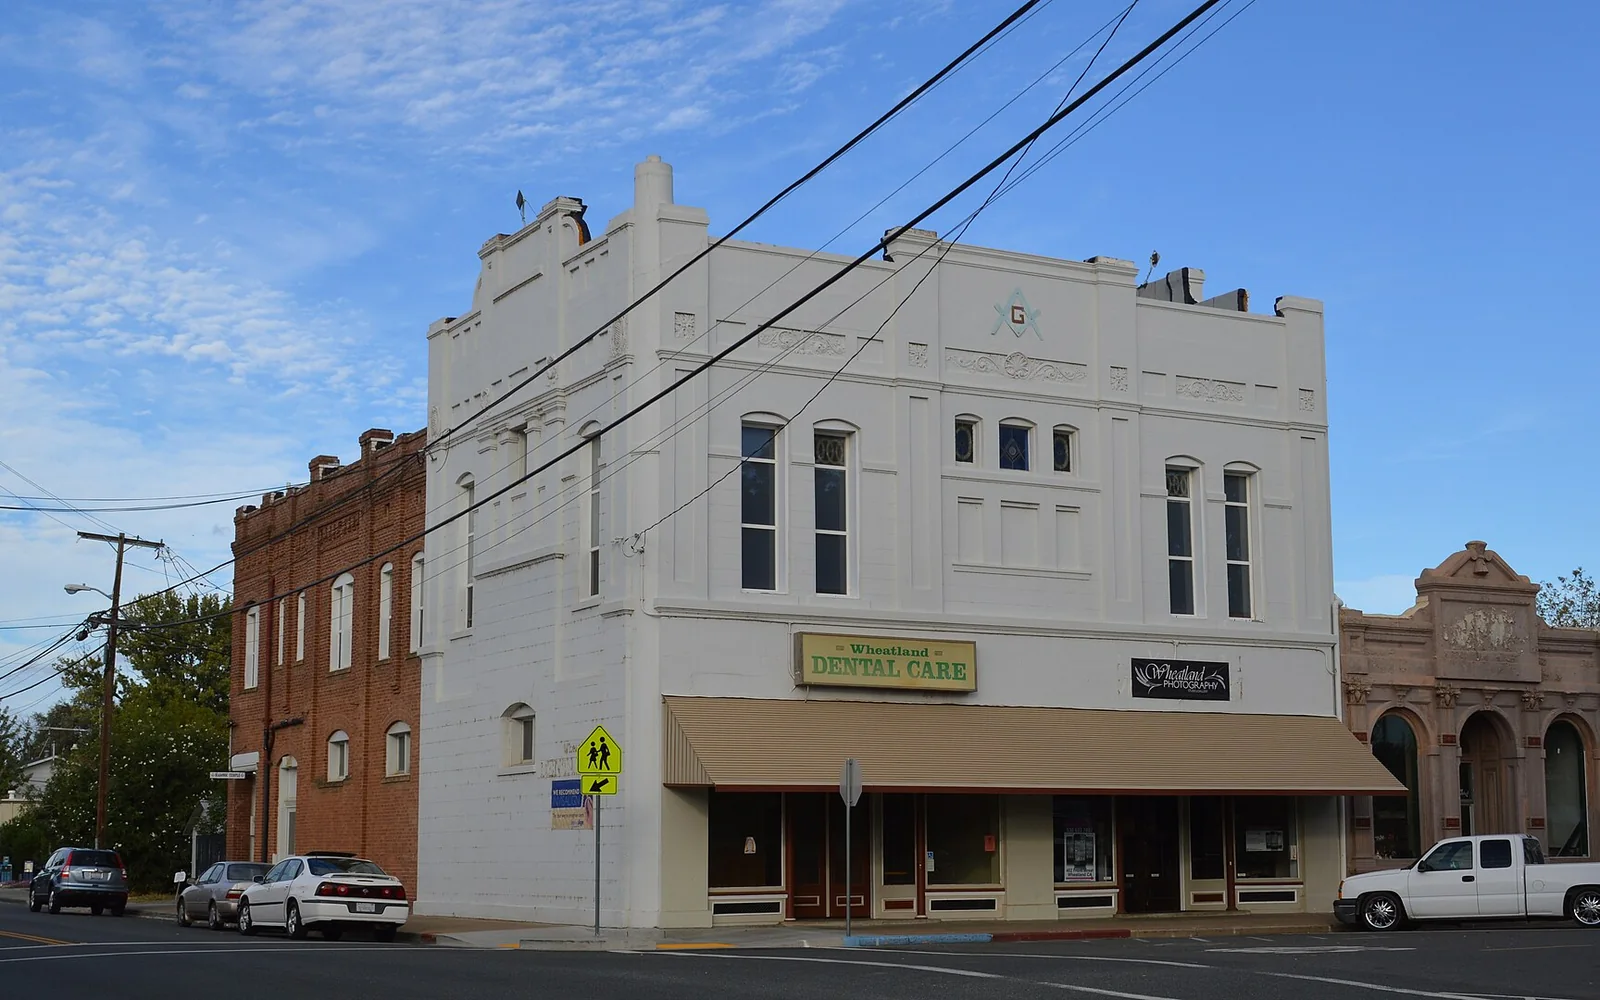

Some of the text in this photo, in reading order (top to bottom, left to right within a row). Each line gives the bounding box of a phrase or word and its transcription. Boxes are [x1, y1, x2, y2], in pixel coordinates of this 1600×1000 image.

[1011, 305, 1025, 324] G
[850, 643, 929, 658] Wheatland
[811, 655, 967, 681] DENTAL CARE
[1145, 662, 1206, 682] Wheatland
[1163, 680, 1219, 690] PHOTOGRAPHY
